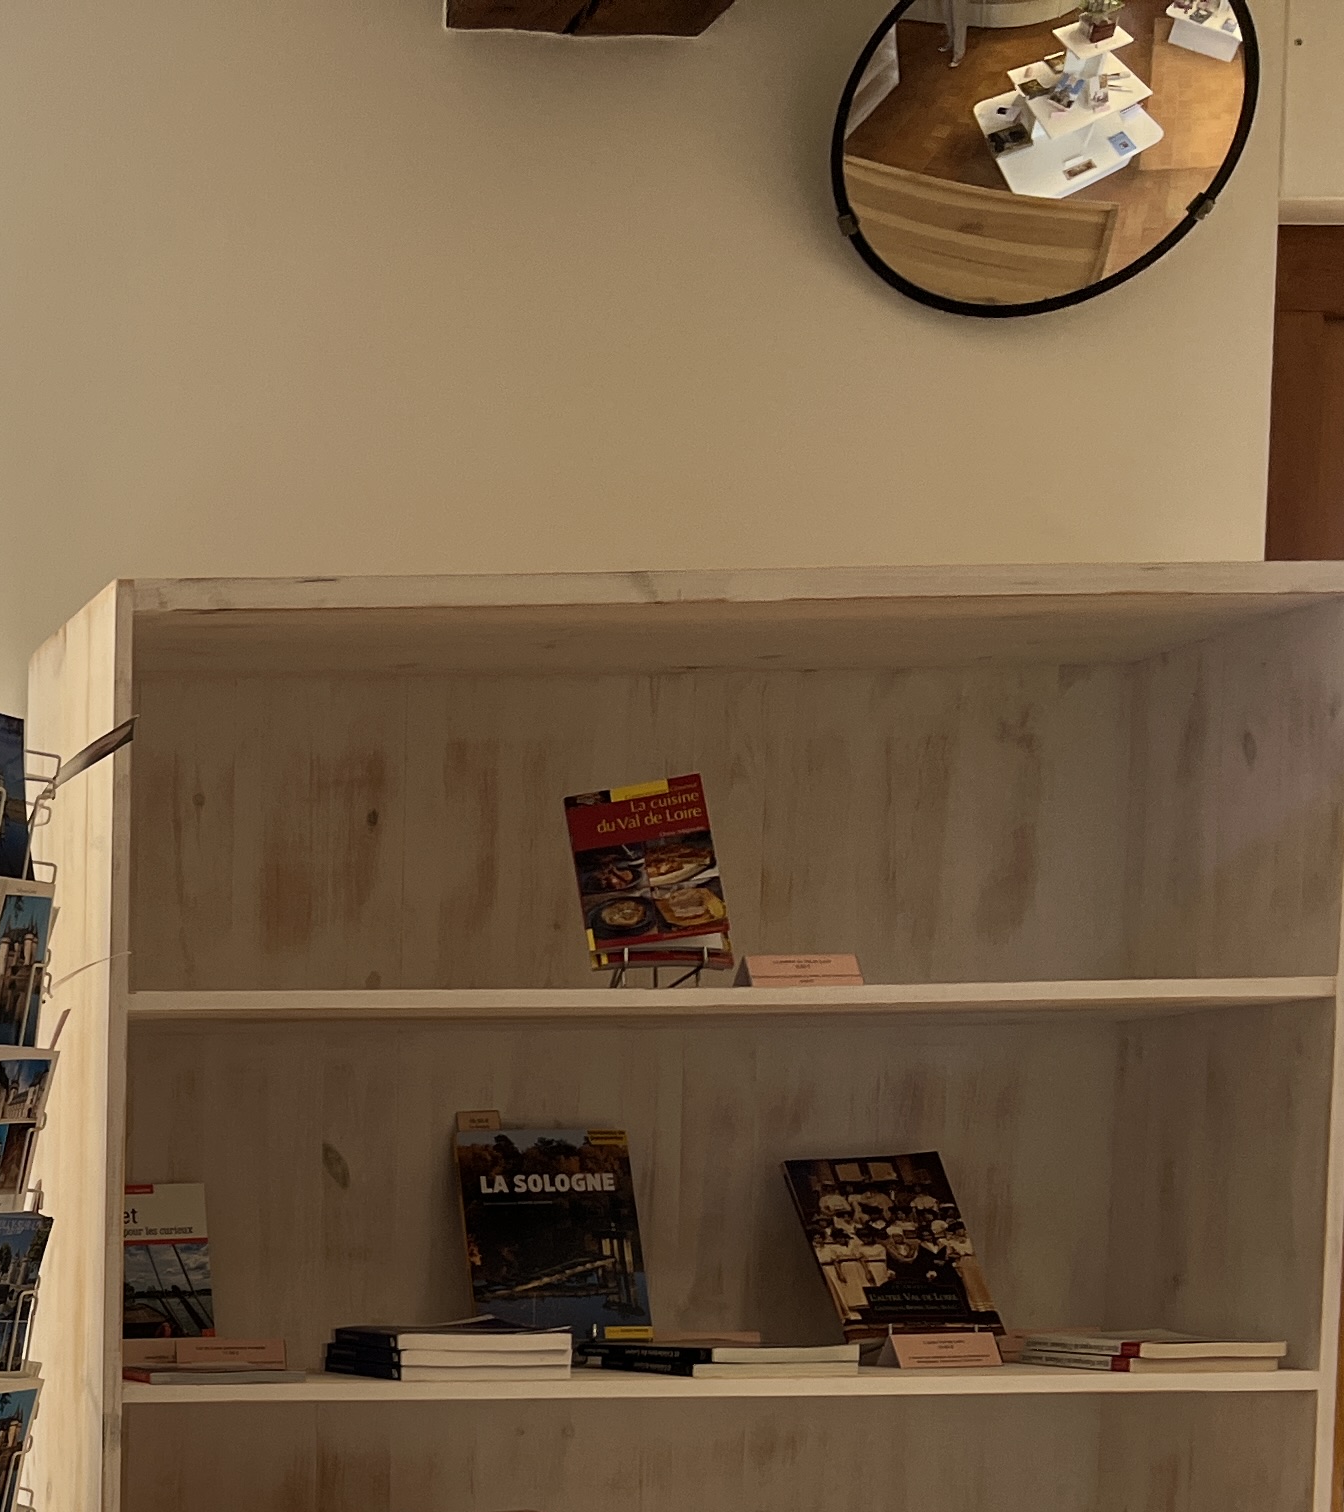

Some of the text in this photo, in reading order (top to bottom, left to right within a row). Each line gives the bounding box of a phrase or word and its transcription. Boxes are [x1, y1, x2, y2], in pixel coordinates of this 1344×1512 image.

[630, 791, 700, 813] La cuisine
[596, 806, 703, 833] du Val de Loire
[480, 1173, 616, 1194] LA SOLOGNE
[145, 1227, 158, 1236] les
[159, 1226, 194, 1236] curieux
